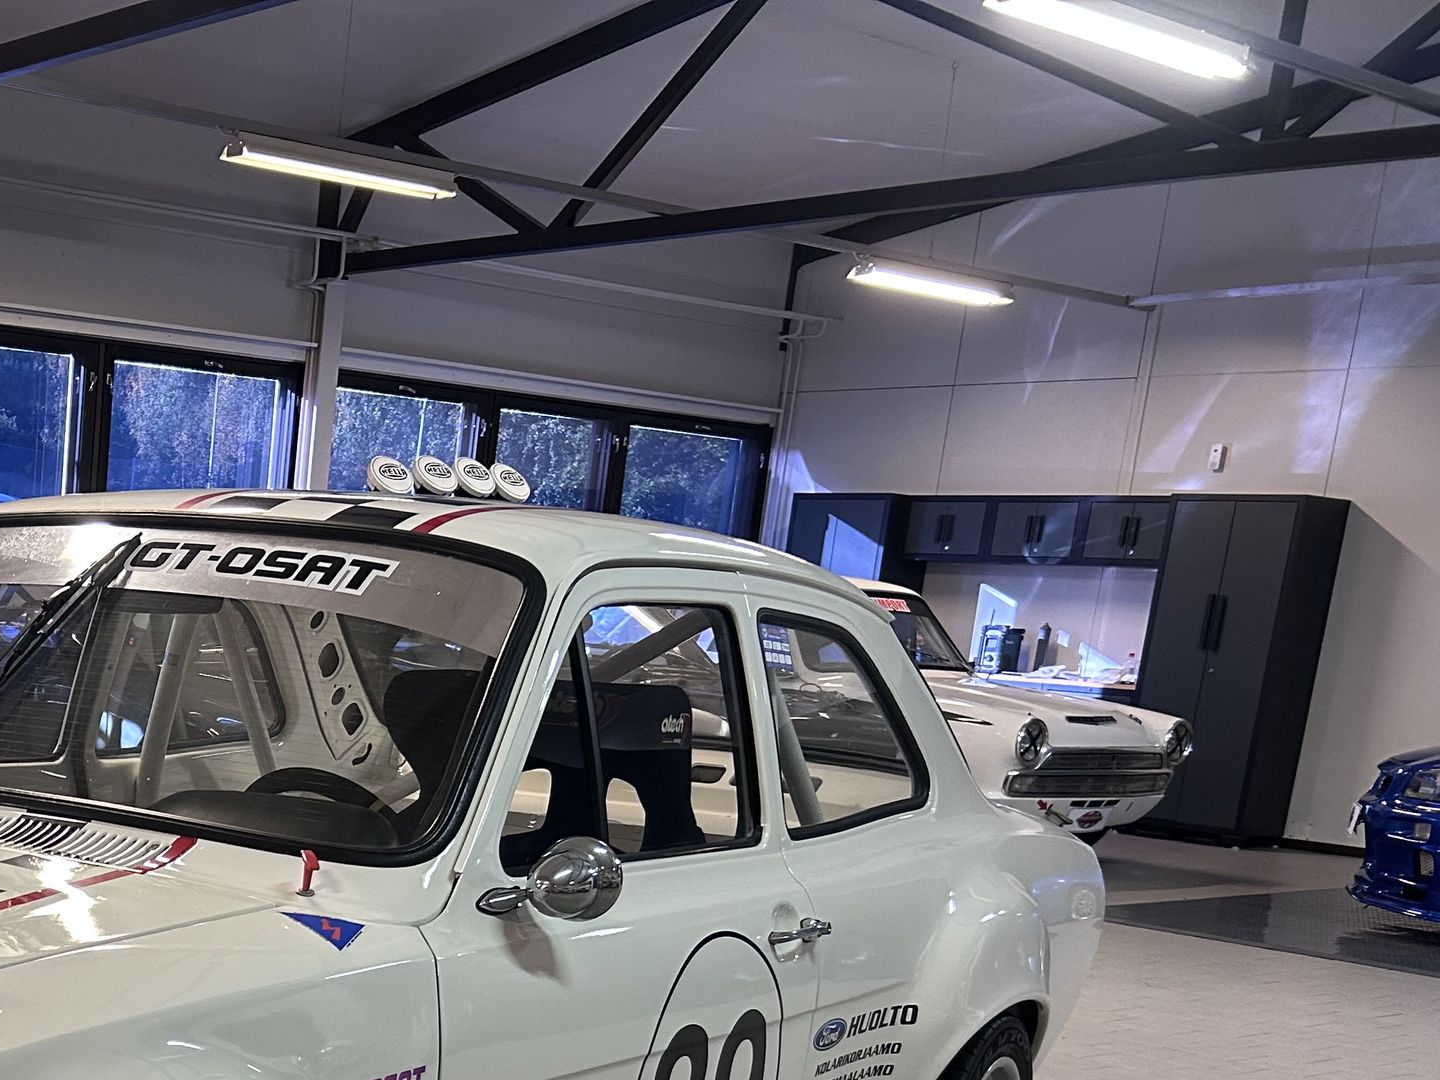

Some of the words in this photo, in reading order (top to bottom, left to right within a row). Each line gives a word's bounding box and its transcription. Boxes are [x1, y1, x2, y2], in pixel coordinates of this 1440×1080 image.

[381, 467, 407, 477] HELLA
[427, 466, 451, 476] HELLA
[466, 468, 489, 478] HELLA
[502, 474, 524, 484] HELLA
[128, 541, 392, 592] GT-OSAT
[846, 1004, 919, 1038] HUOLTO
[814, 1042, 903, 1077] KOLARIKORJAAMO
